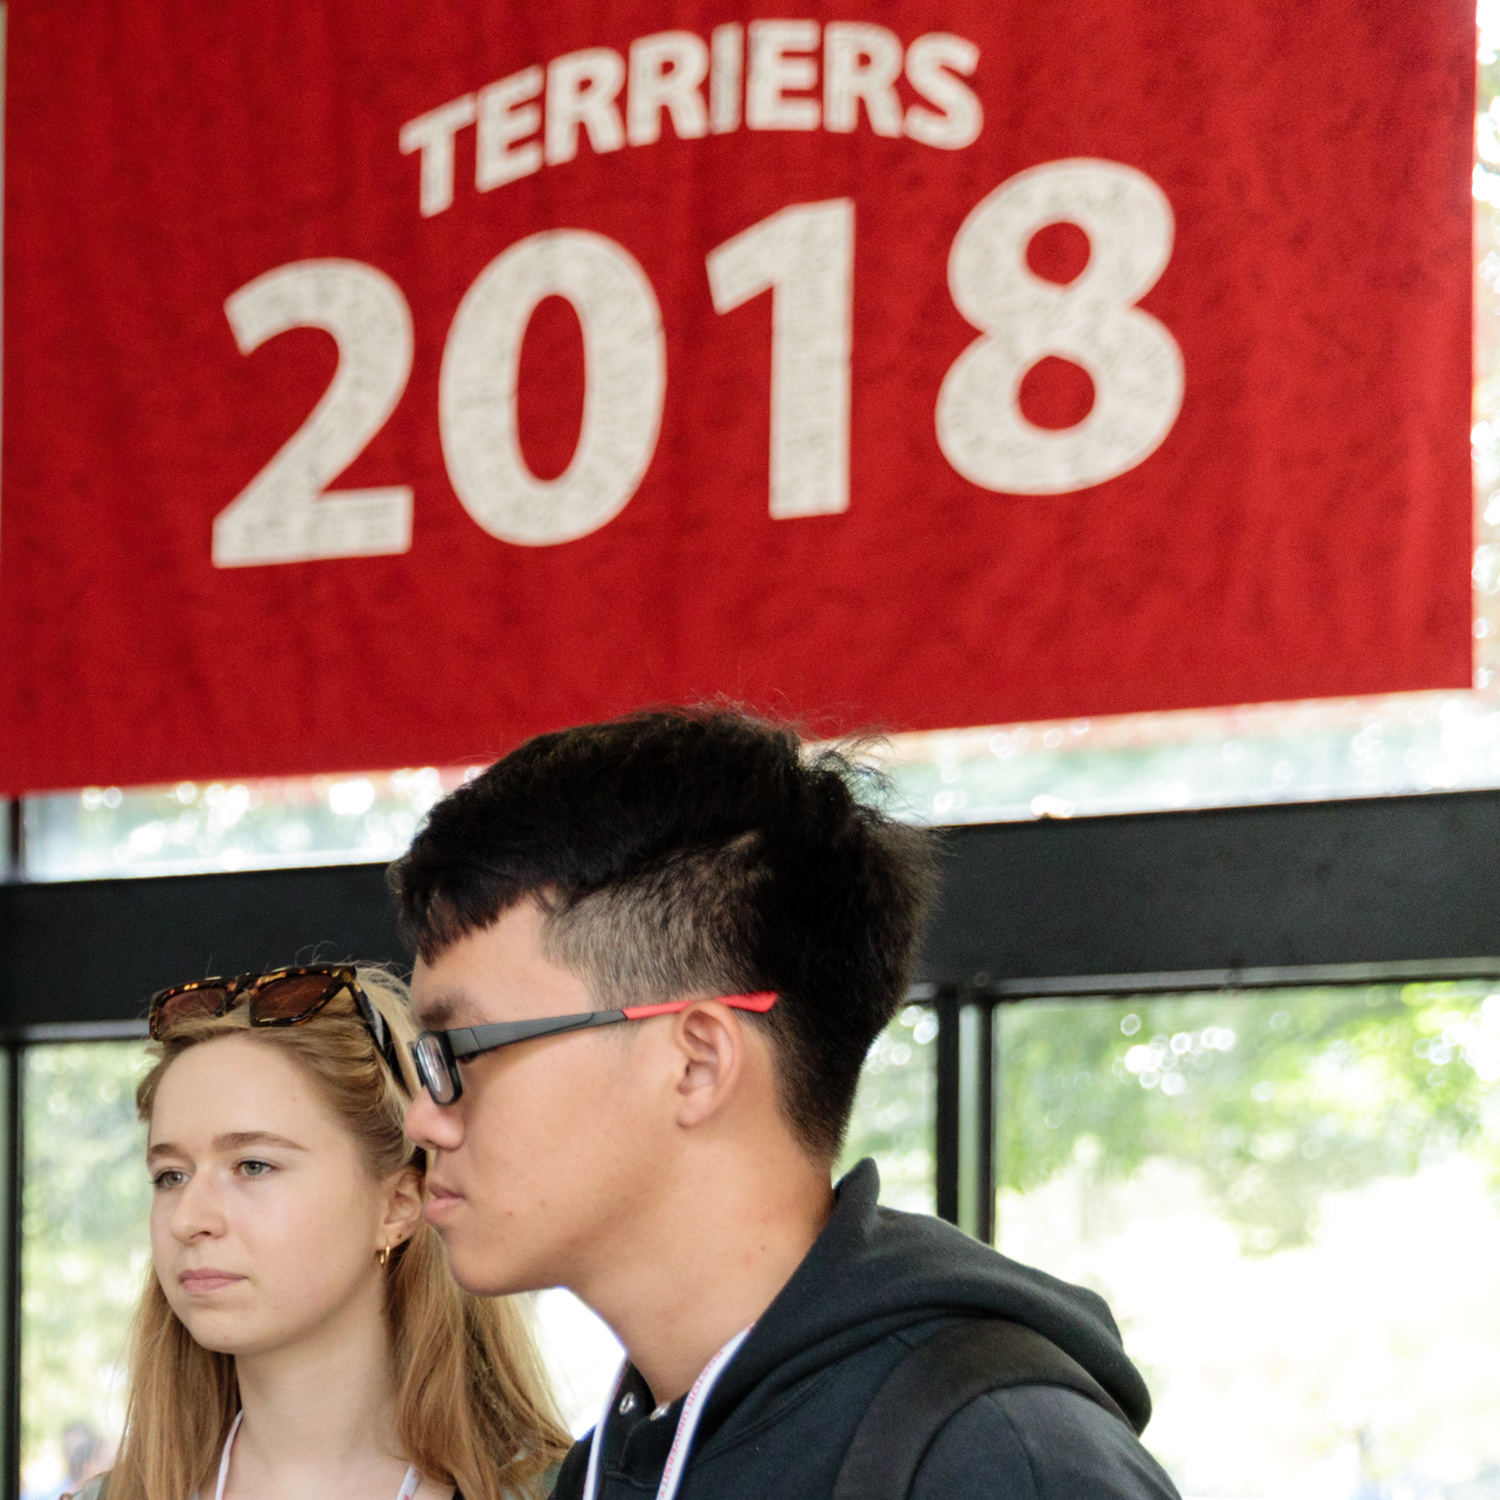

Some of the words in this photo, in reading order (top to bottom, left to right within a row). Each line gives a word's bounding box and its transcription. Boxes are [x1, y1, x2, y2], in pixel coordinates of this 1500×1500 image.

[399, 17, 985, 217] TERRIERS
[212, 156, 1185, 569] 2018
[686, 1351, 723, 1408] BOSTON
